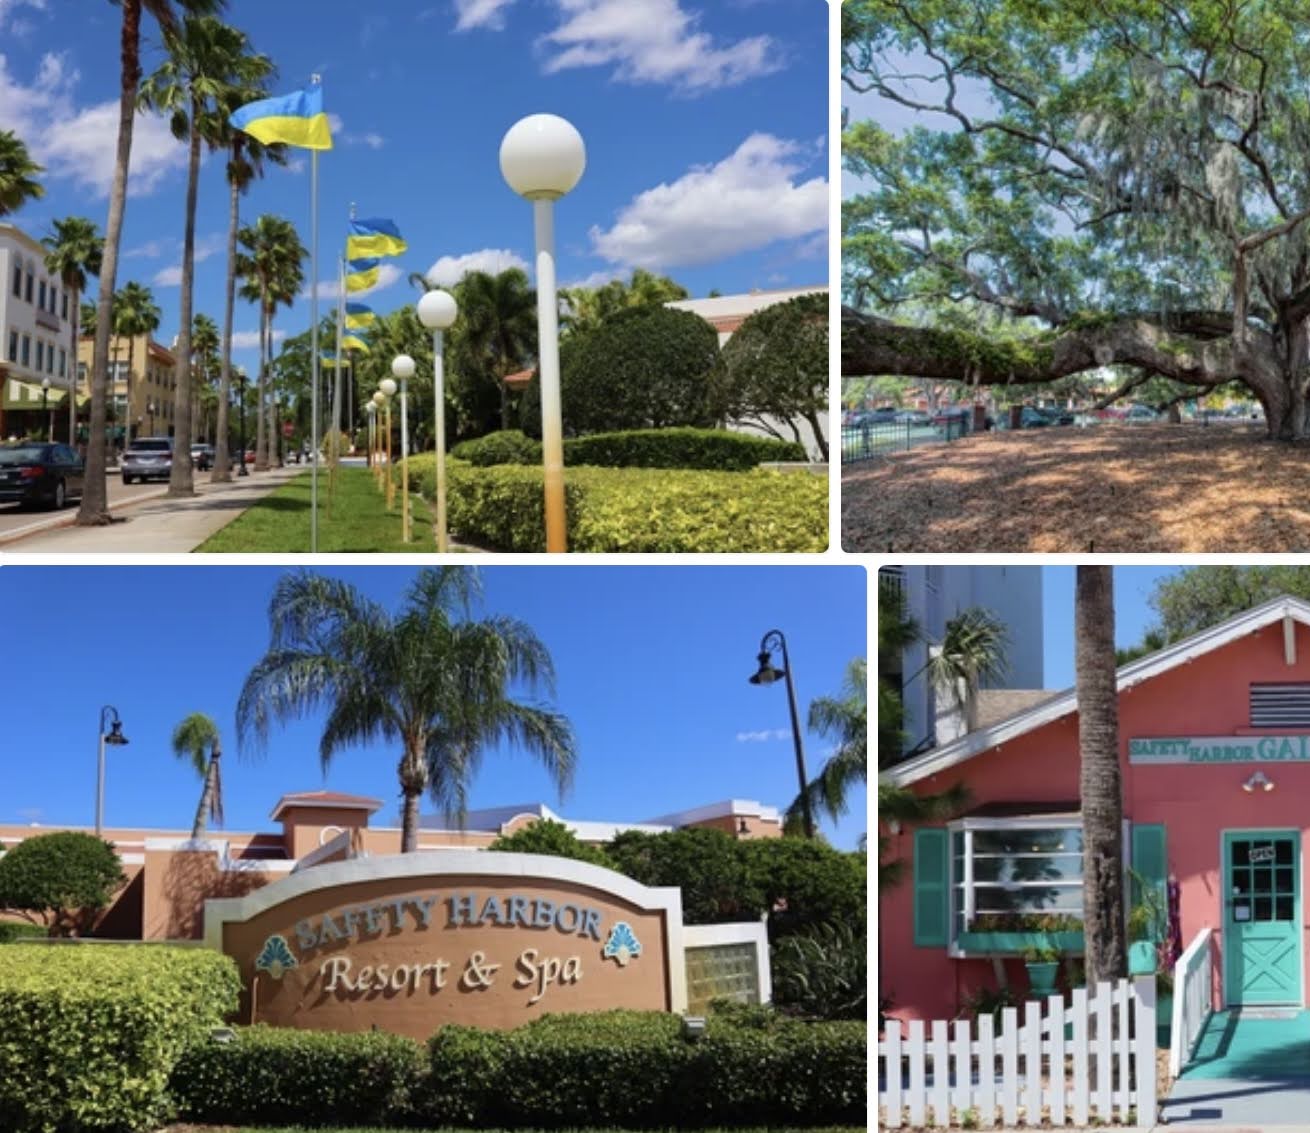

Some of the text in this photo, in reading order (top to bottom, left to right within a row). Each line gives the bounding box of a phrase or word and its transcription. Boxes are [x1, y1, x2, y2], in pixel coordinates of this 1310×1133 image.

[1131, 738, 1191, 755] SAFETY
[1189, 746, 1255, 762] HARBOR
[295, 892, 604, 950] SAFETY HARBOR
[319, 948, 584, 1002] Resort & Spa
